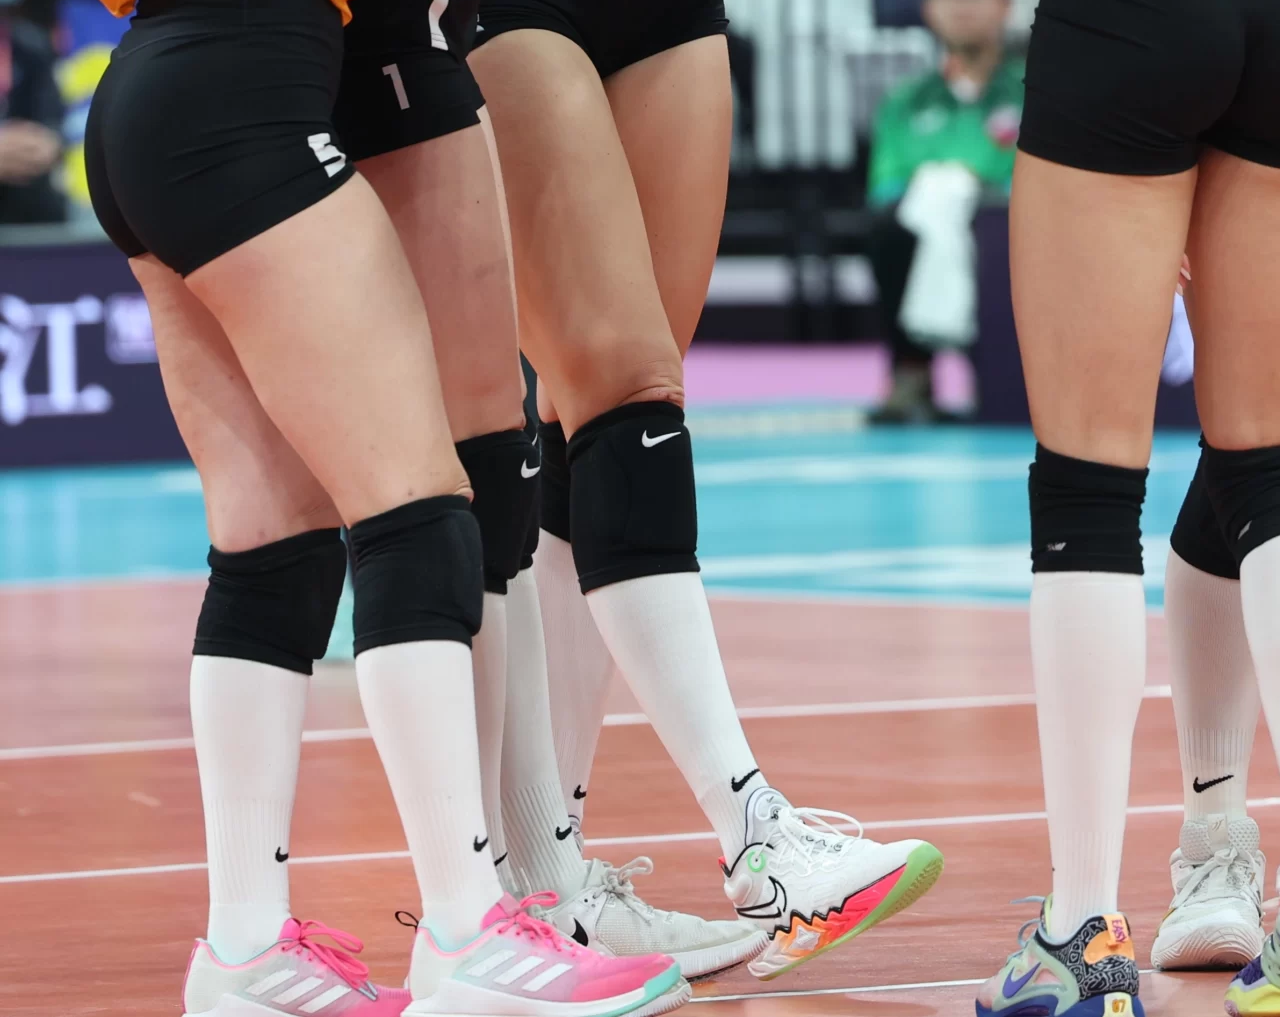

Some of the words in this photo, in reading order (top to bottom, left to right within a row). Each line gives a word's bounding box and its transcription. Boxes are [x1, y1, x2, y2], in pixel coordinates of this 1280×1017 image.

[382, 63, 410, 110] 1
[307, 133, 347, 178] 5
[1111, 919, 1127, 943] EASY
[1112, 999, 1126, 1013] 07
